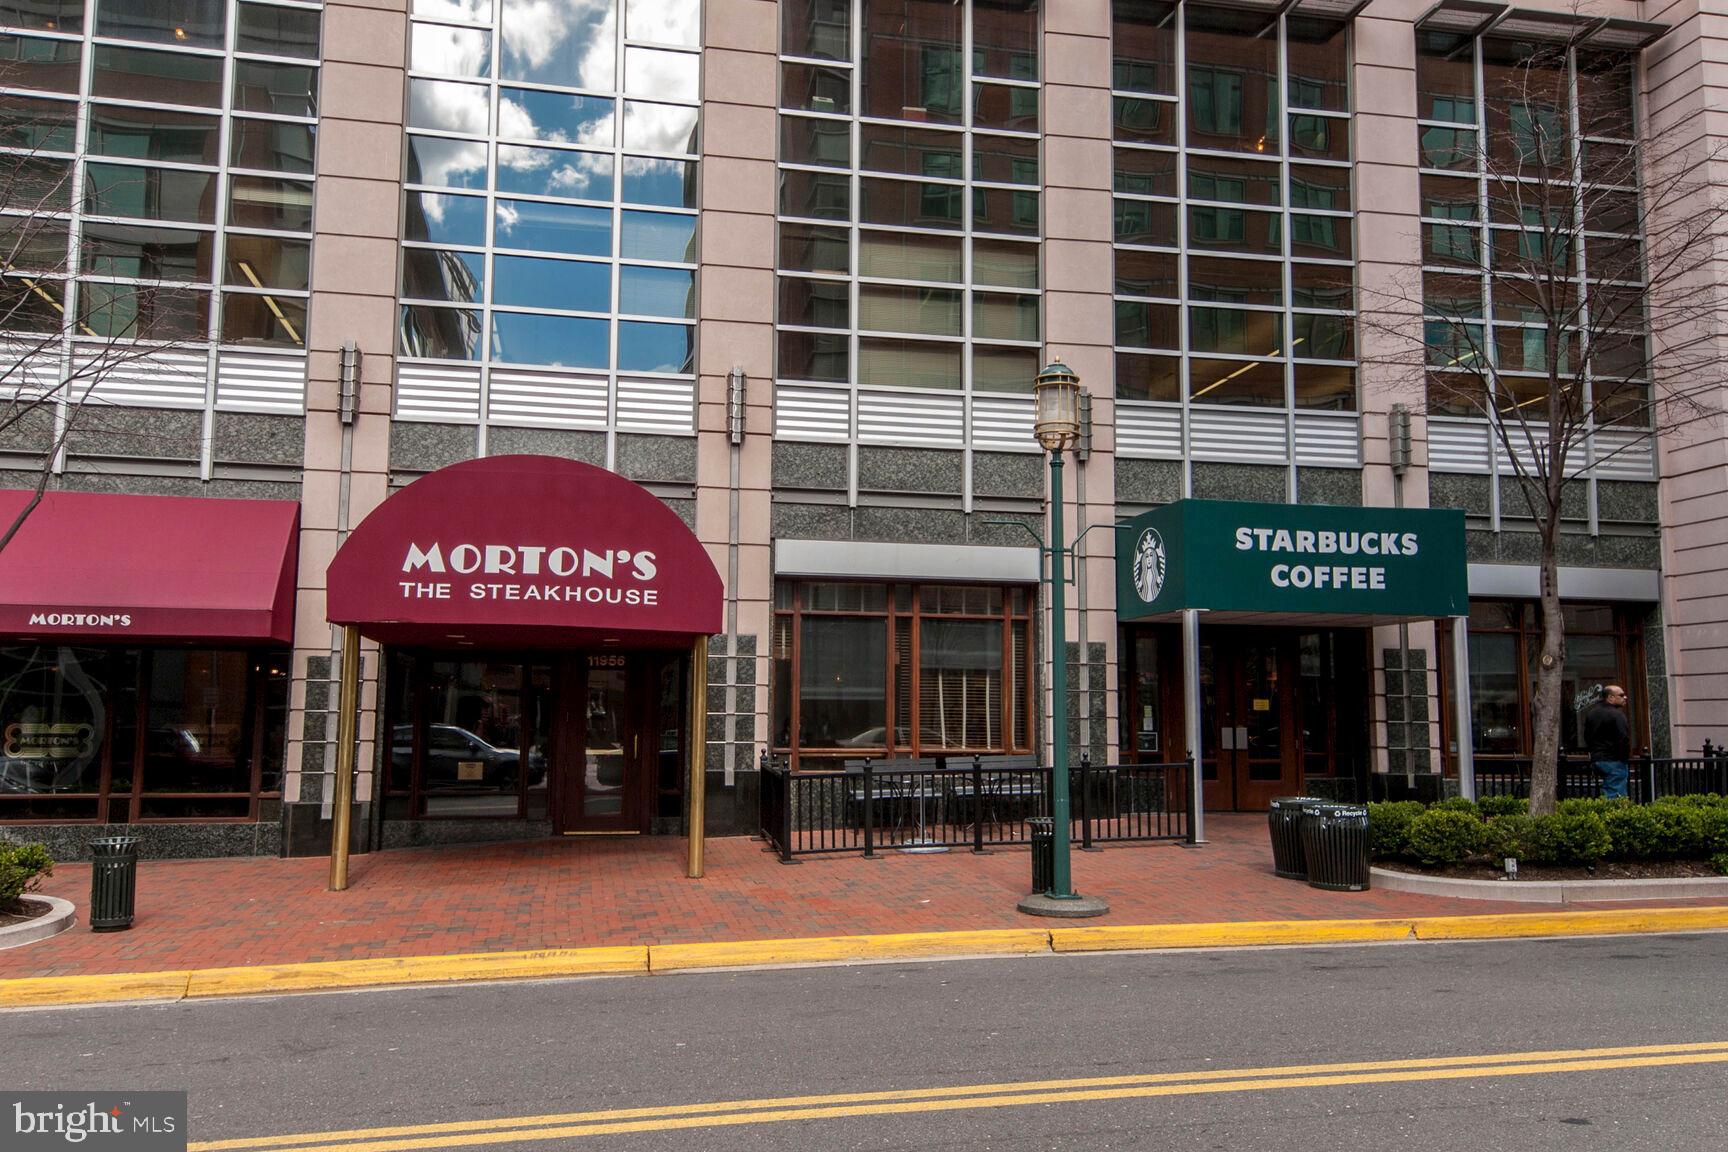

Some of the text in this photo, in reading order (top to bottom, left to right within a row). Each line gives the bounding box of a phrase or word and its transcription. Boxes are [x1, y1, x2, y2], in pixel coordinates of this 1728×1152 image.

[1235, 526, 1419, 556] STARBUCKS
[398, 541, 657, 581] MORTON'S
[1270, 564, 1387, 590] COFFEE
[398, 581, 658, 606] THE STEAKHOUSE
[28, 613, 132, 627] MORTON'S
[587, 655, 626, 667] 11956
[20, 736, 80, 746] MORTON'S
[1341, 810, 1363, 818] Recycle
